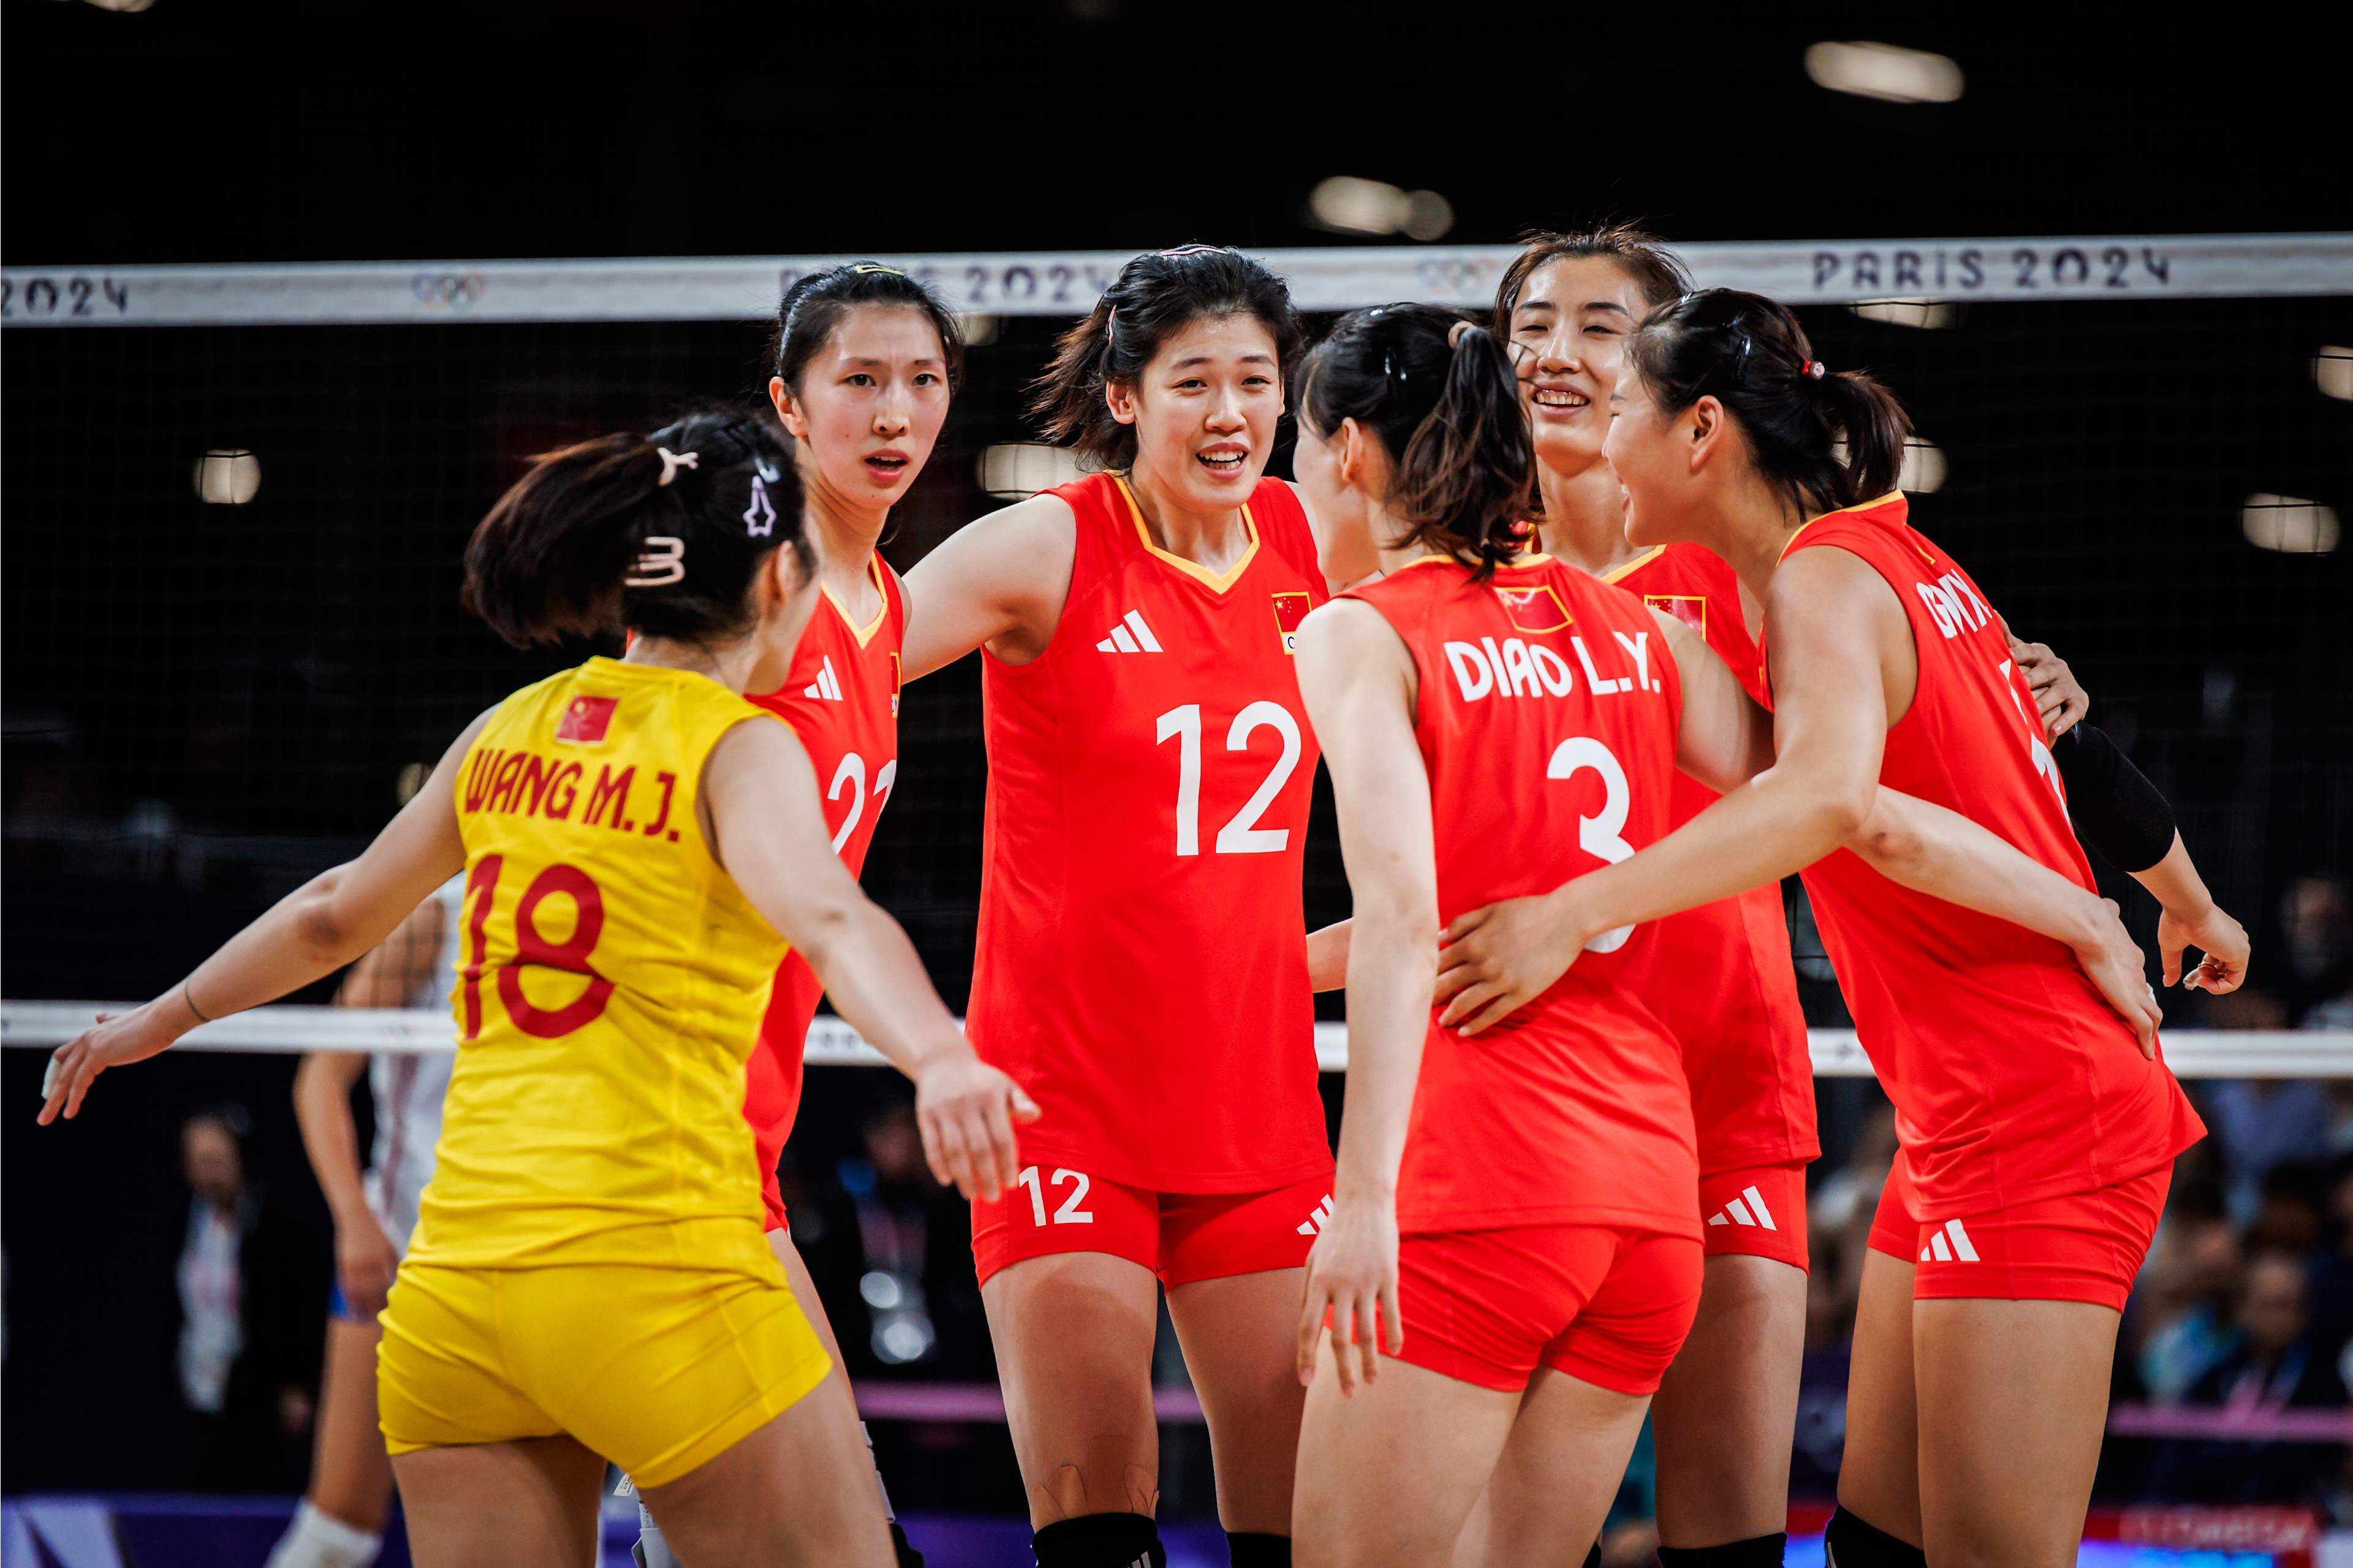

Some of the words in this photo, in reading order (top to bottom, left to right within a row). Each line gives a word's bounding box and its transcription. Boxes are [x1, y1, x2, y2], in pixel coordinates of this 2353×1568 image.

[1812, 249, 1984, 290] PARIS
[2011, 247, 2170, 288] 2024
[1444, 637, 1573, 702] DIAO
[464, 748, 583, 821] WANG
[1156, 700, 1302, 856] 12
[1546, 736, 1635, 953] 3
[463, 853, 617, 1042] 18
[1018, 1165, 1094, 1227] 12
